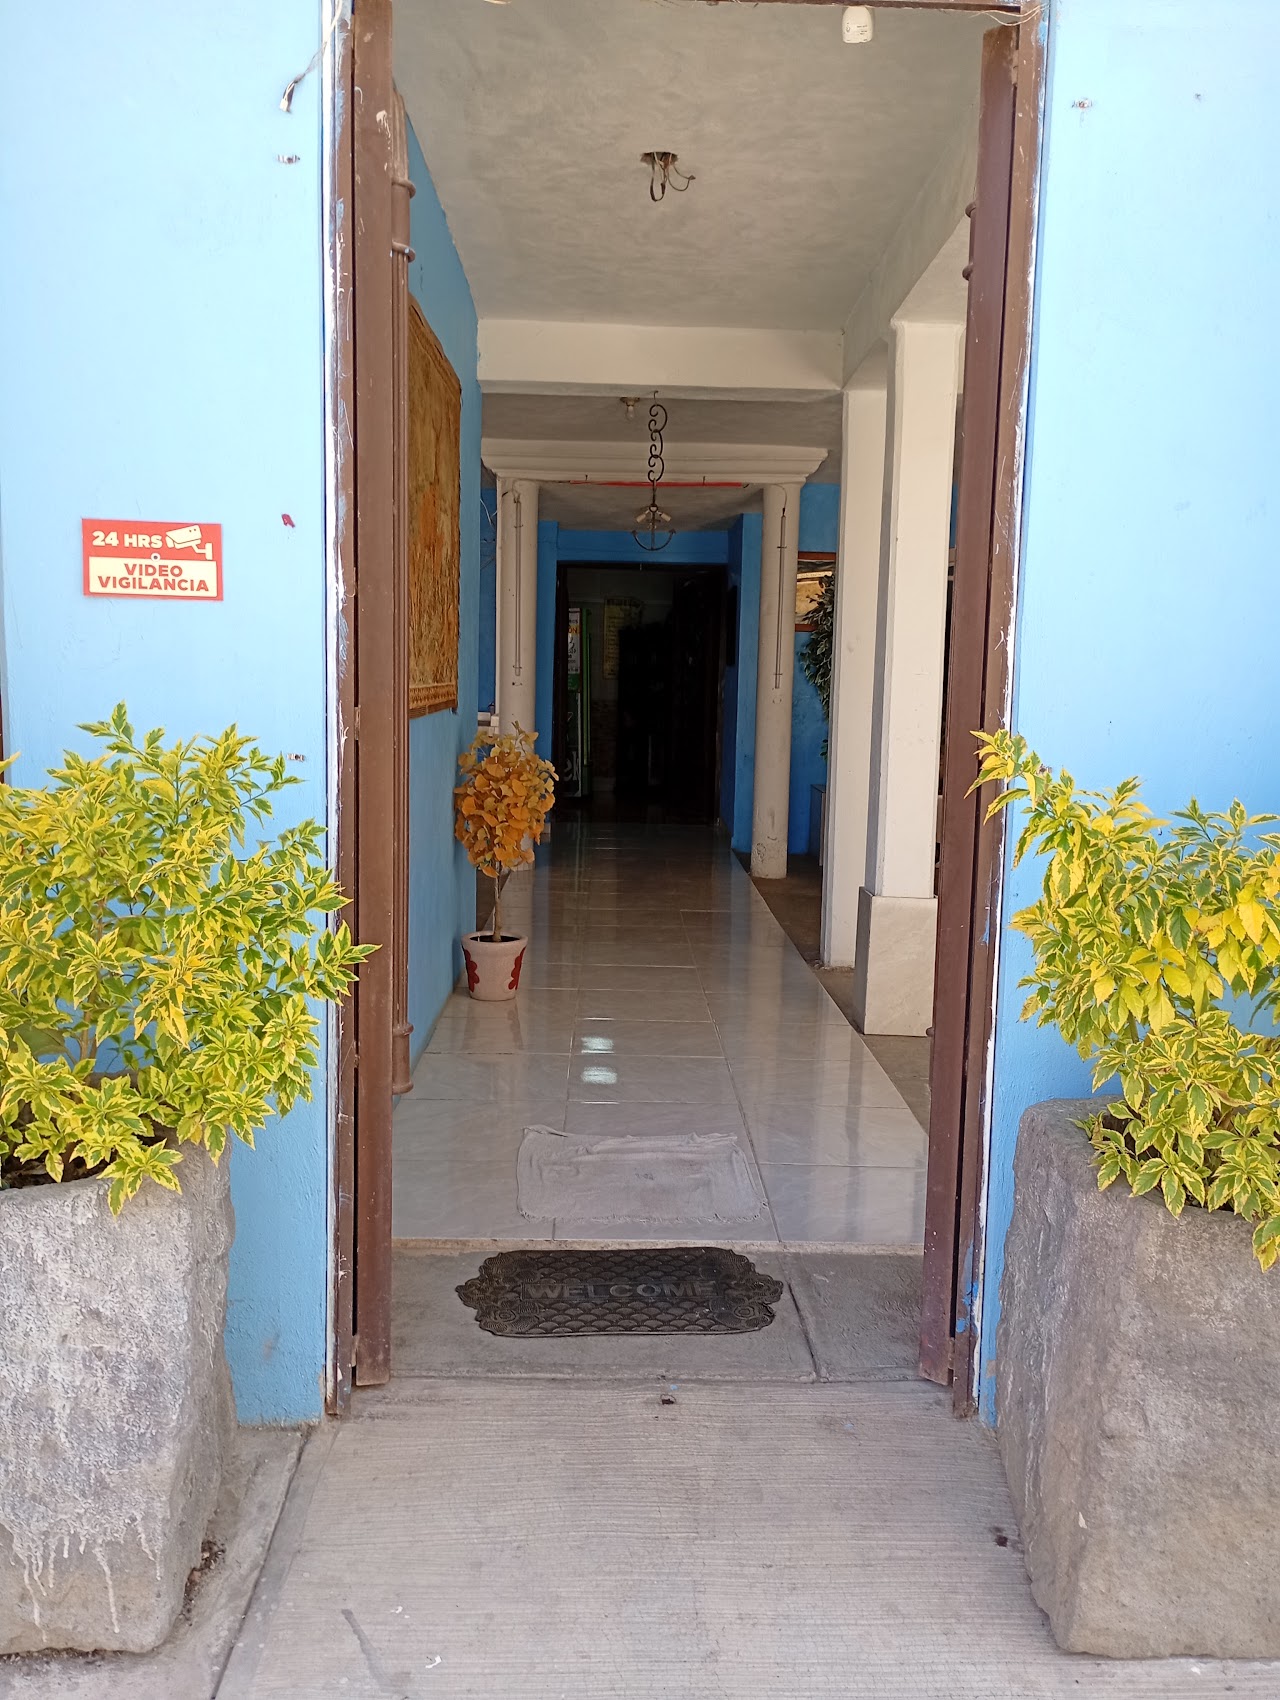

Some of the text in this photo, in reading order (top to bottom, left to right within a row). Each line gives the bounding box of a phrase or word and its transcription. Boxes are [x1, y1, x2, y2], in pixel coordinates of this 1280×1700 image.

[92, 531, 163, 549] 24 HRS
[124, 563, 183, 577] VIDEO
[97, 576, 209, 592] VIGILANCIA
[524, 1281, 716, 1299] WELCOME
